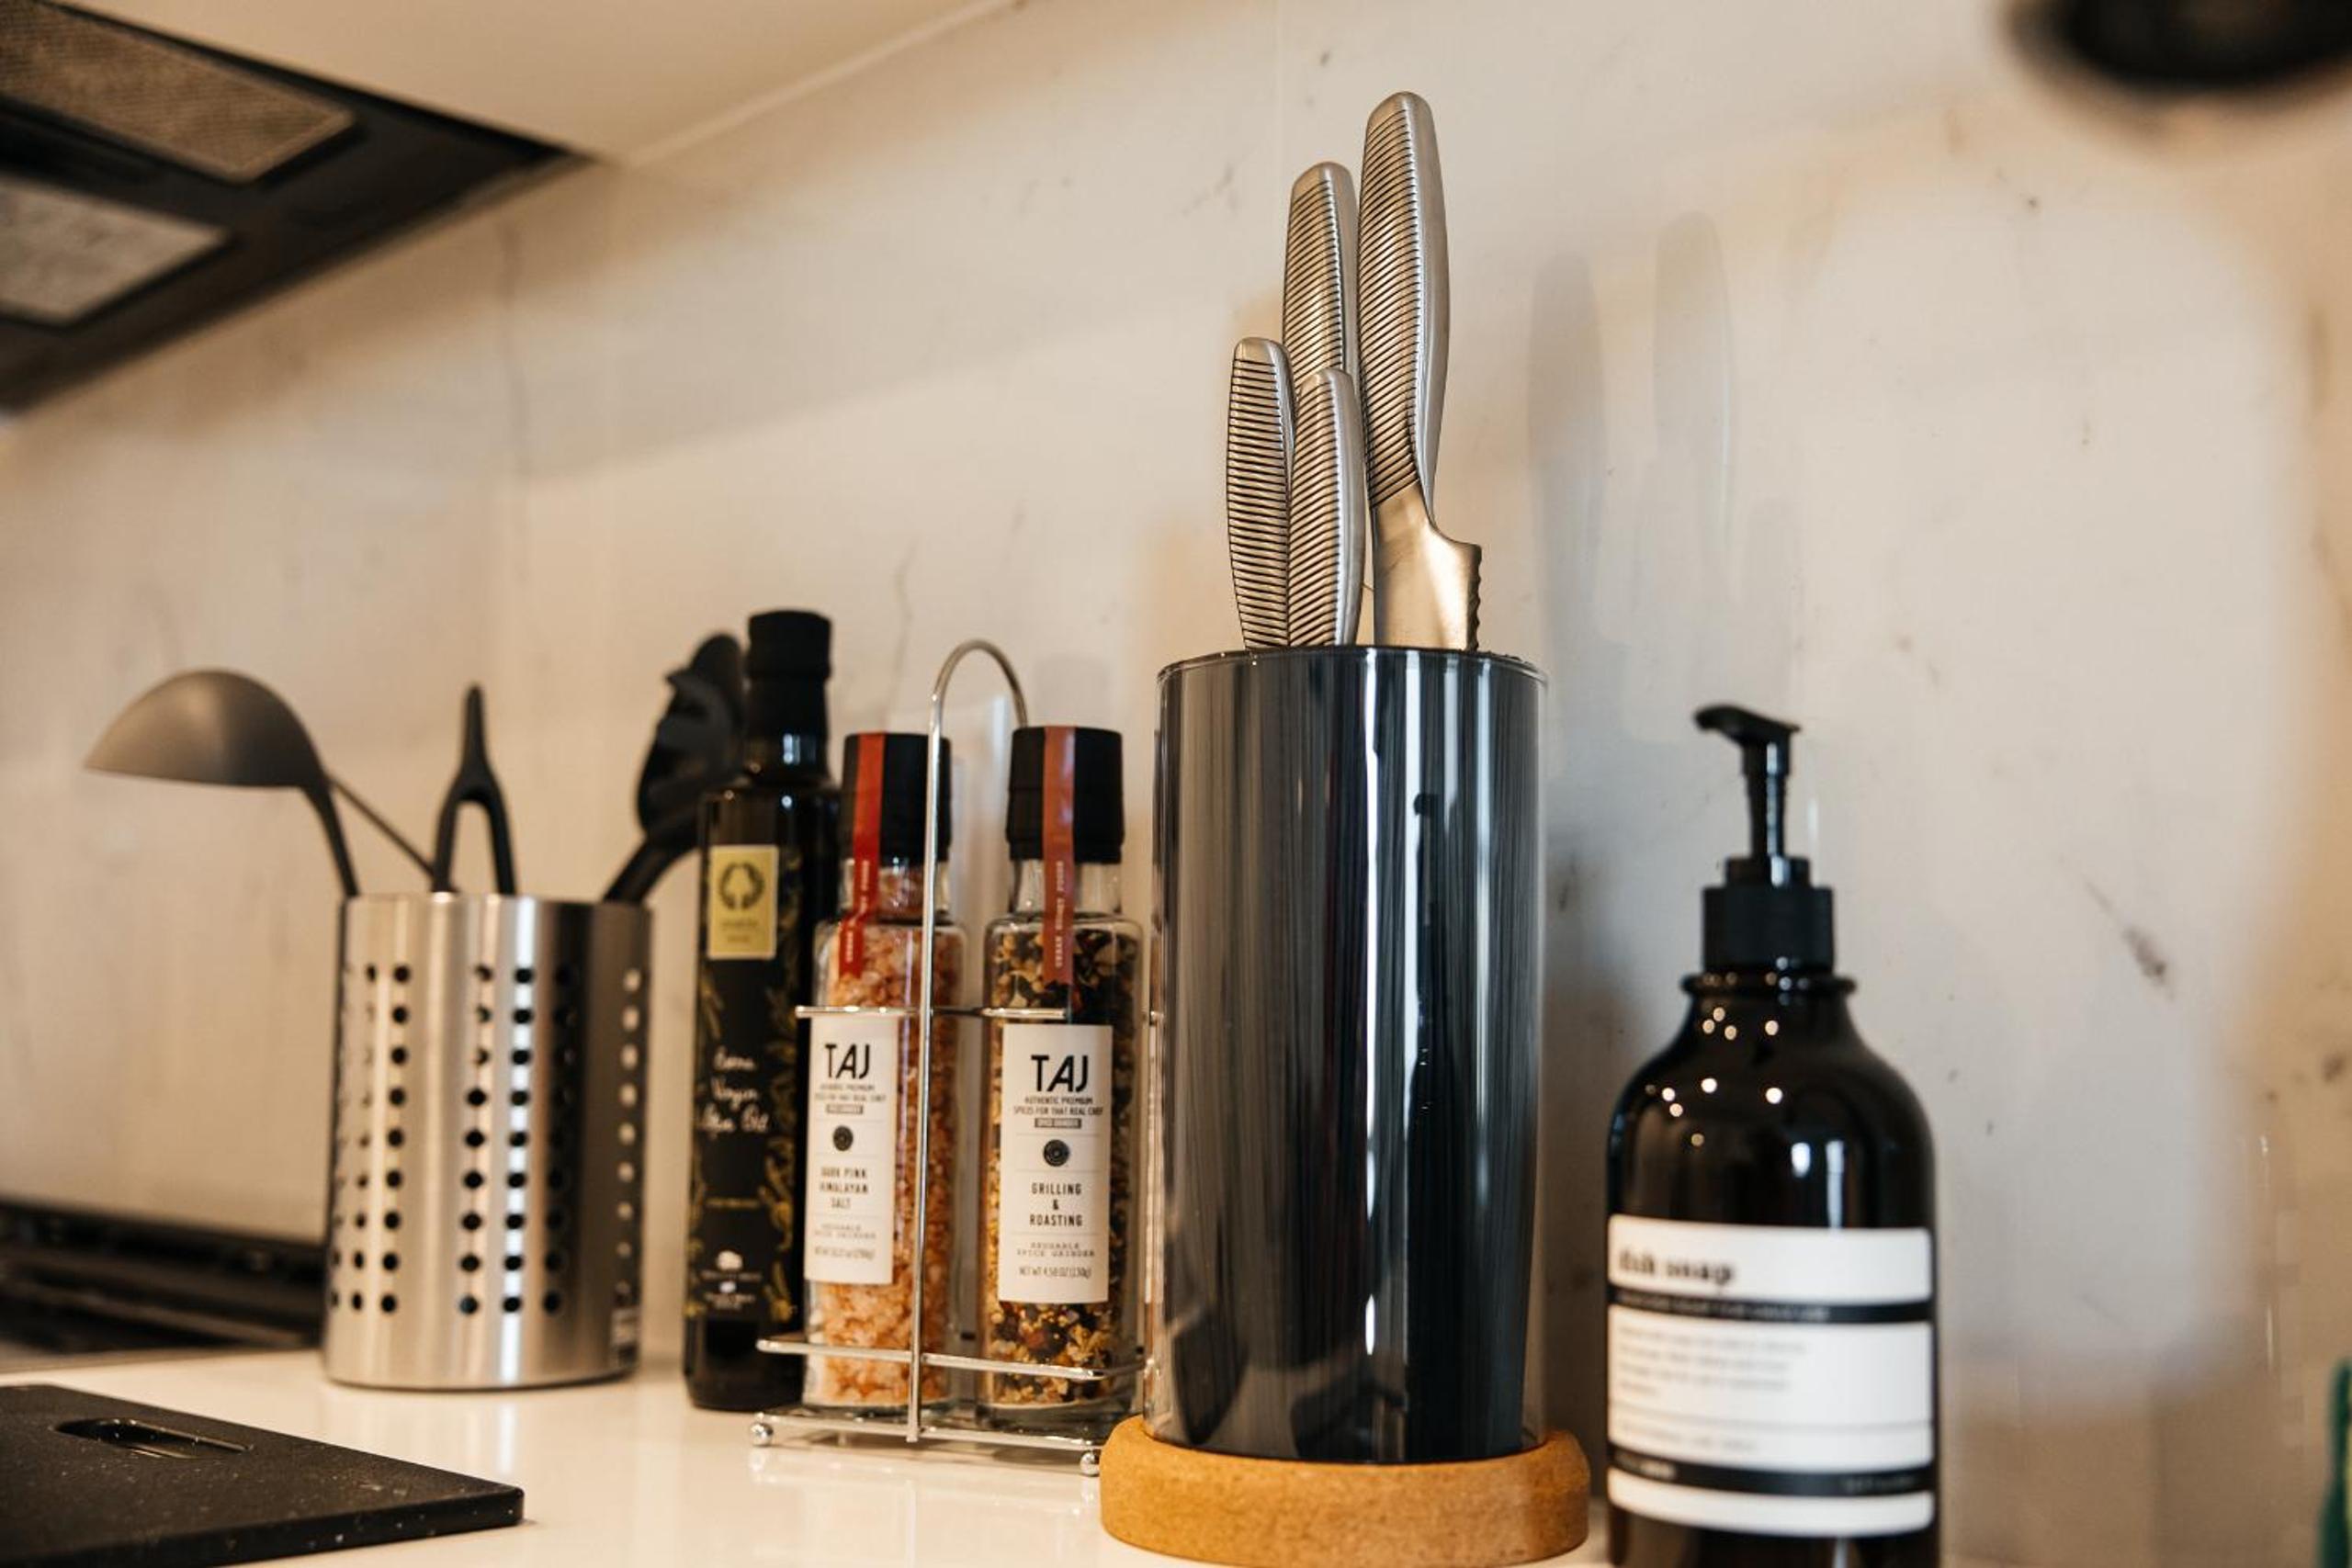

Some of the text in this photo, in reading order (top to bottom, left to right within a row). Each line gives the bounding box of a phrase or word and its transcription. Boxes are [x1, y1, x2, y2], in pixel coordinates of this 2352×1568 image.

[824, 1043, 871, 1080] TAJ
[1030, 1054, 1089, 1093] TAJ
[1031, 1182, 1082, 1195] GRILLING
[1052, 1199, 1059, 1211] &
[1029, 1214, 1082, 1226] ROASTING
